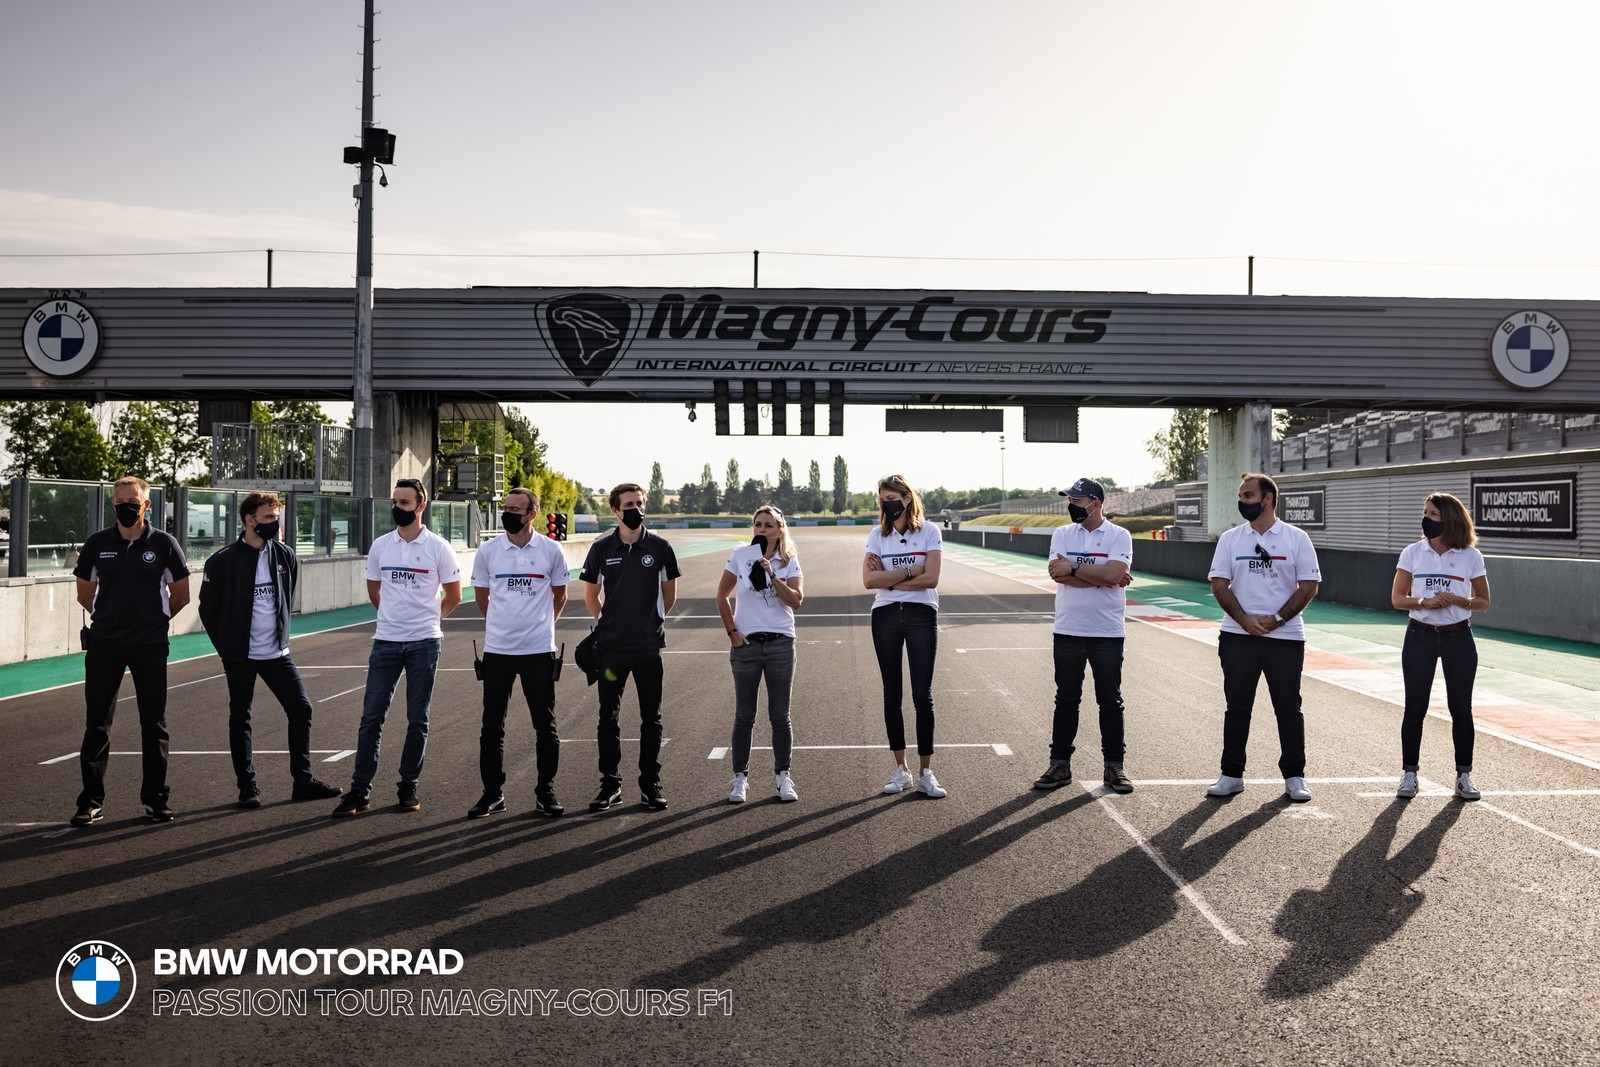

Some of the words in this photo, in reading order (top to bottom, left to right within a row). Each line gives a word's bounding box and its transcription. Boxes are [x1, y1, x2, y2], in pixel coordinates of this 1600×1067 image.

[33, 302, 90, 323] BMW
[646, 293, 1112, 351] Magny-Cours
[1501, 313, 1561, 335] BMW
[635, 359, 820, 372] INTERNATIONAL
[828, 361, 922, 373] CIRCUIT
[937, 362, 1012, 374] NEVERS
[1018, 363, 1093, 375] FRANCE
[1482, 492, 1493, 505] MY
[1493, 491, 1508, 505] DAY
[1508, 491, 1538, 505] STARTS
[1538, 490, 1560, 505] WITH
[1482, 508, 1511, 521] LAUNCH
[892, 556, 916, 566] BMW
[1249, 560, 1273, 569] BMW
[391, 571, 415, 580] BMW
[507, 578, 532, 587] BMW
[1425, 578, 1451, 587] BMW
